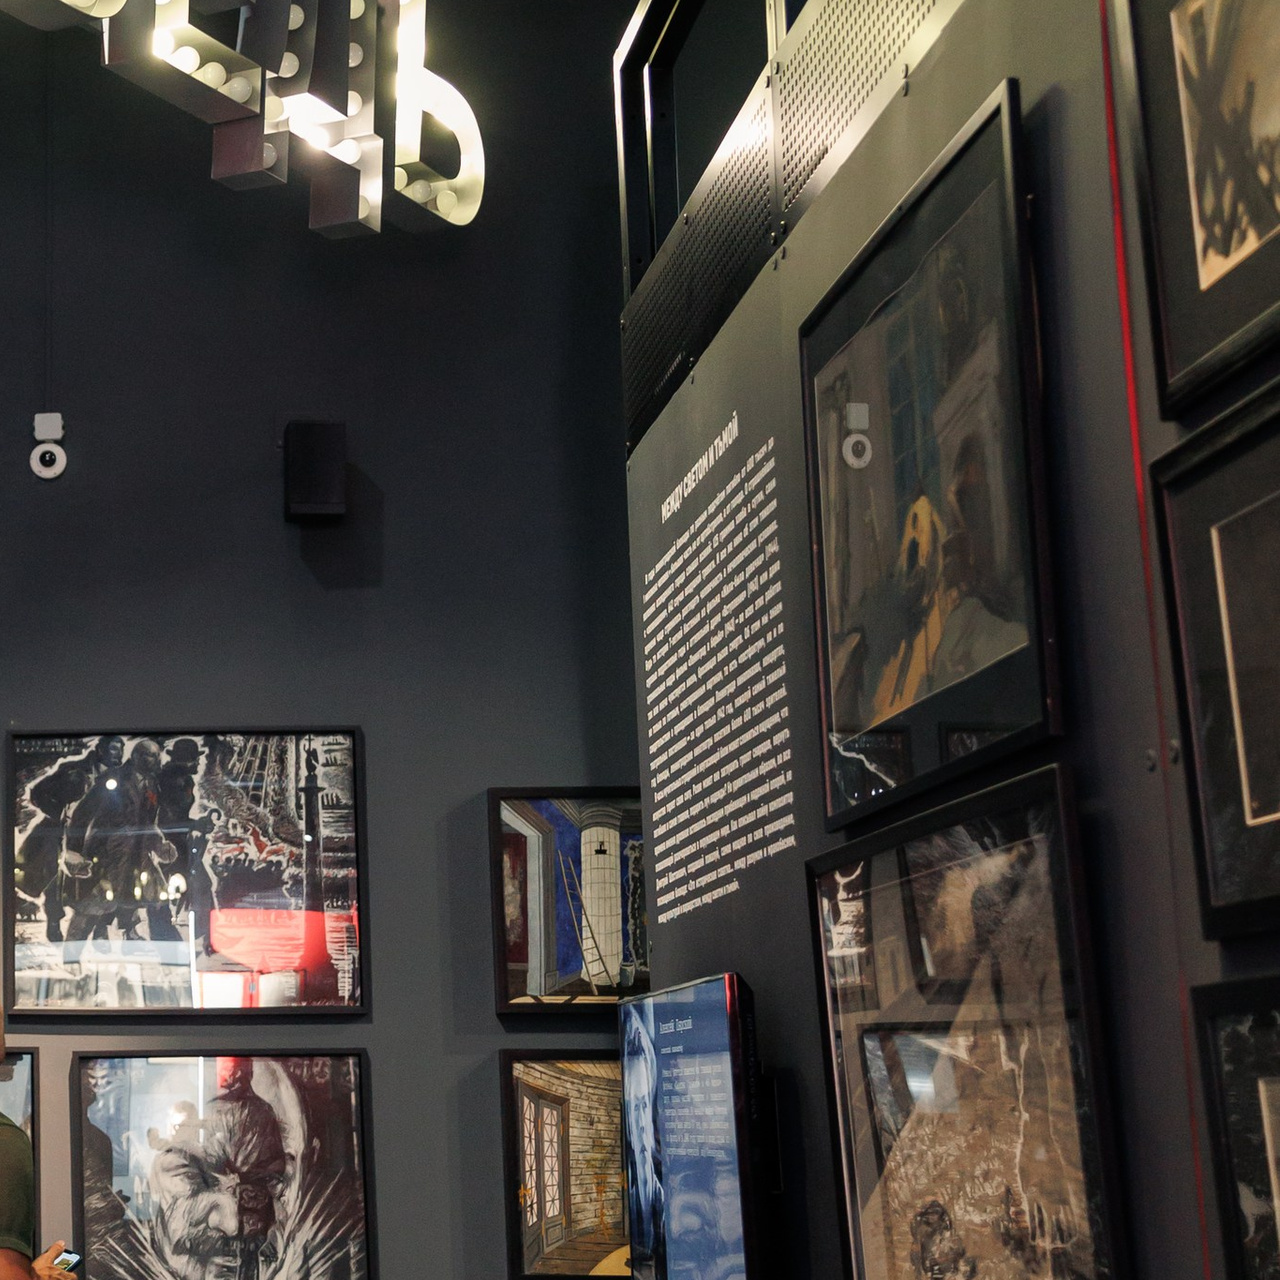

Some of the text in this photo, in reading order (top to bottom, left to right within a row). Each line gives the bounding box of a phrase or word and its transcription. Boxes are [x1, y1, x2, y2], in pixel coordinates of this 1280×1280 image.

[661, 410, 739, 524] МЕЖДУ СВЕТОМ И ТЬМОЙ
